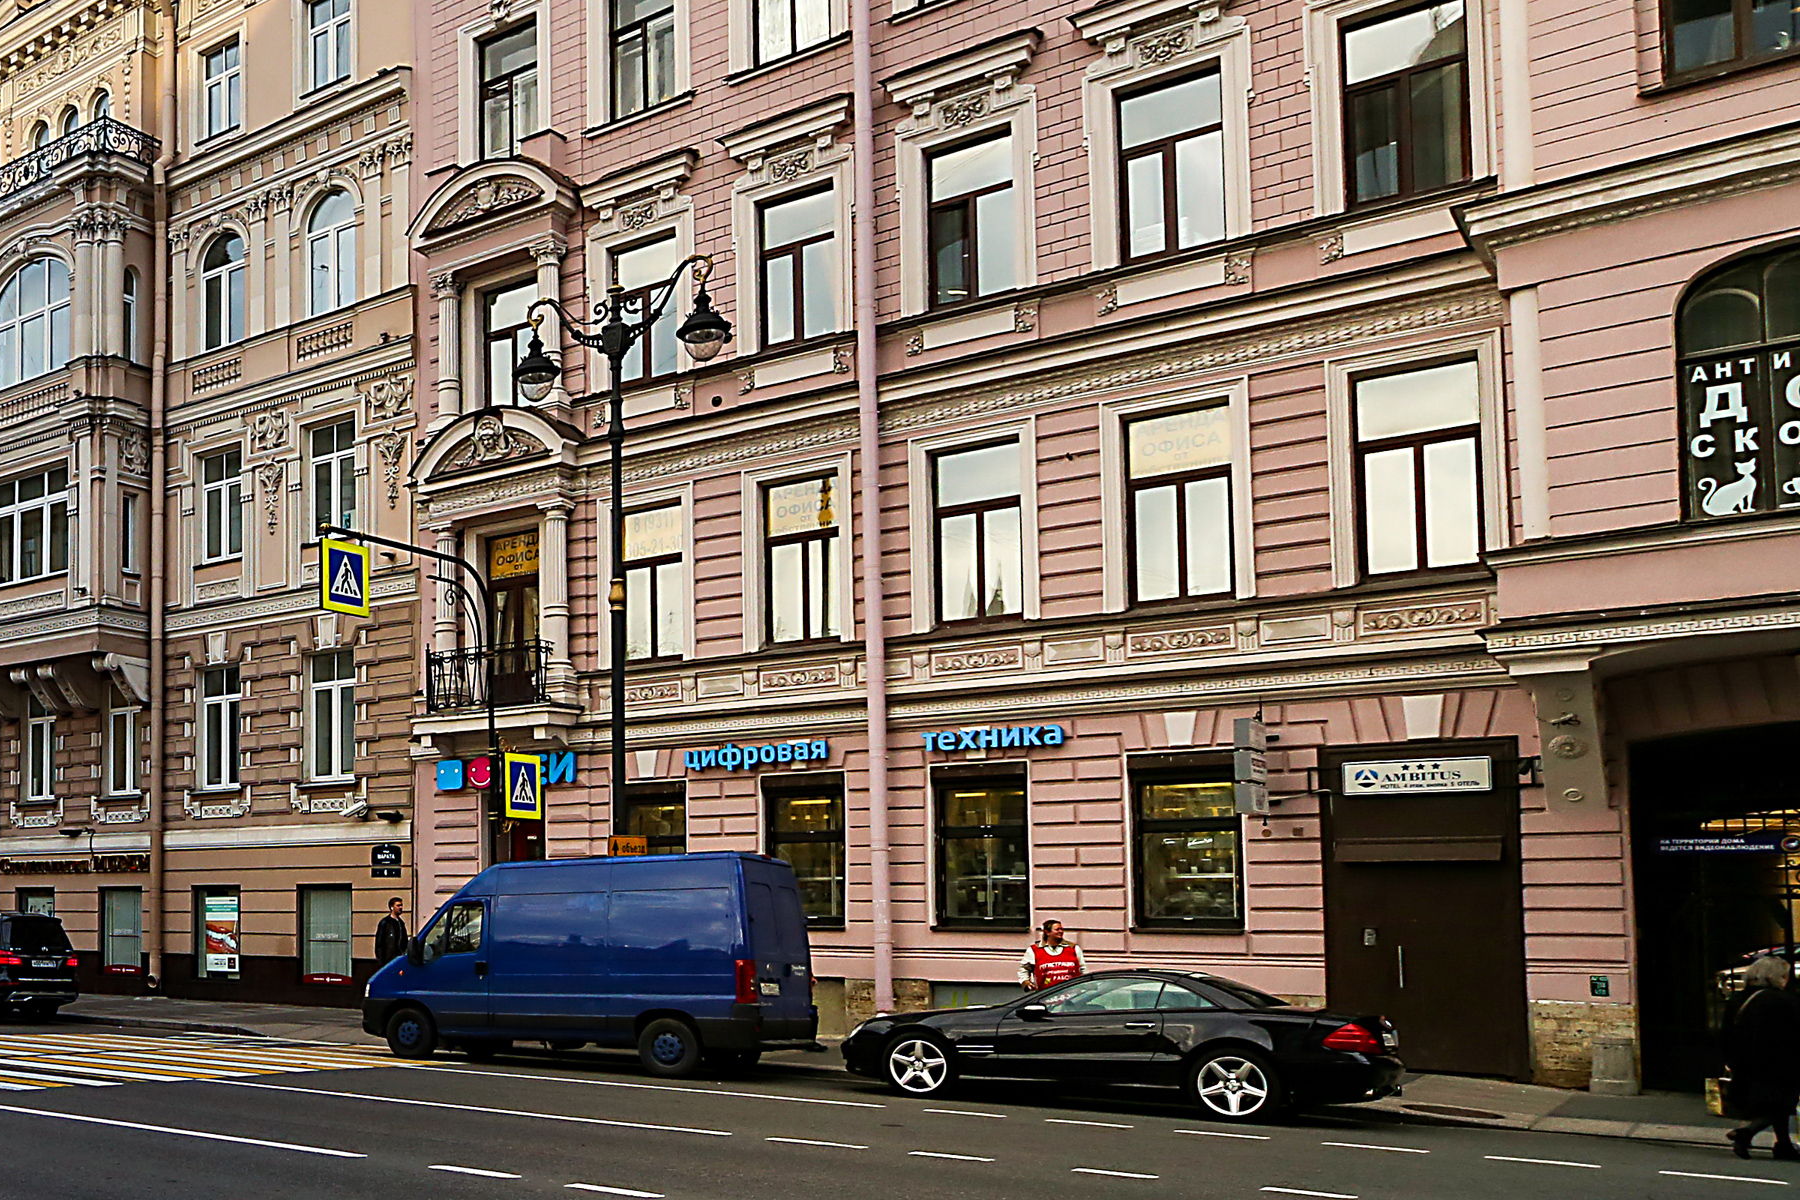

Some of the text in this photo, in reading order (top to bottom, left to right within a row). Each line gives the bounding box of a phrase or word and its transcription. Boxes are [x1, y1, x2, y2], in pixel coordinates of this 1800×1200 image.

[496, 549, 539, 566] ОФИСА
[684, 722, 1064, 771] цифровая техника
[1381, 771, 1462, 783] AMBITUS
